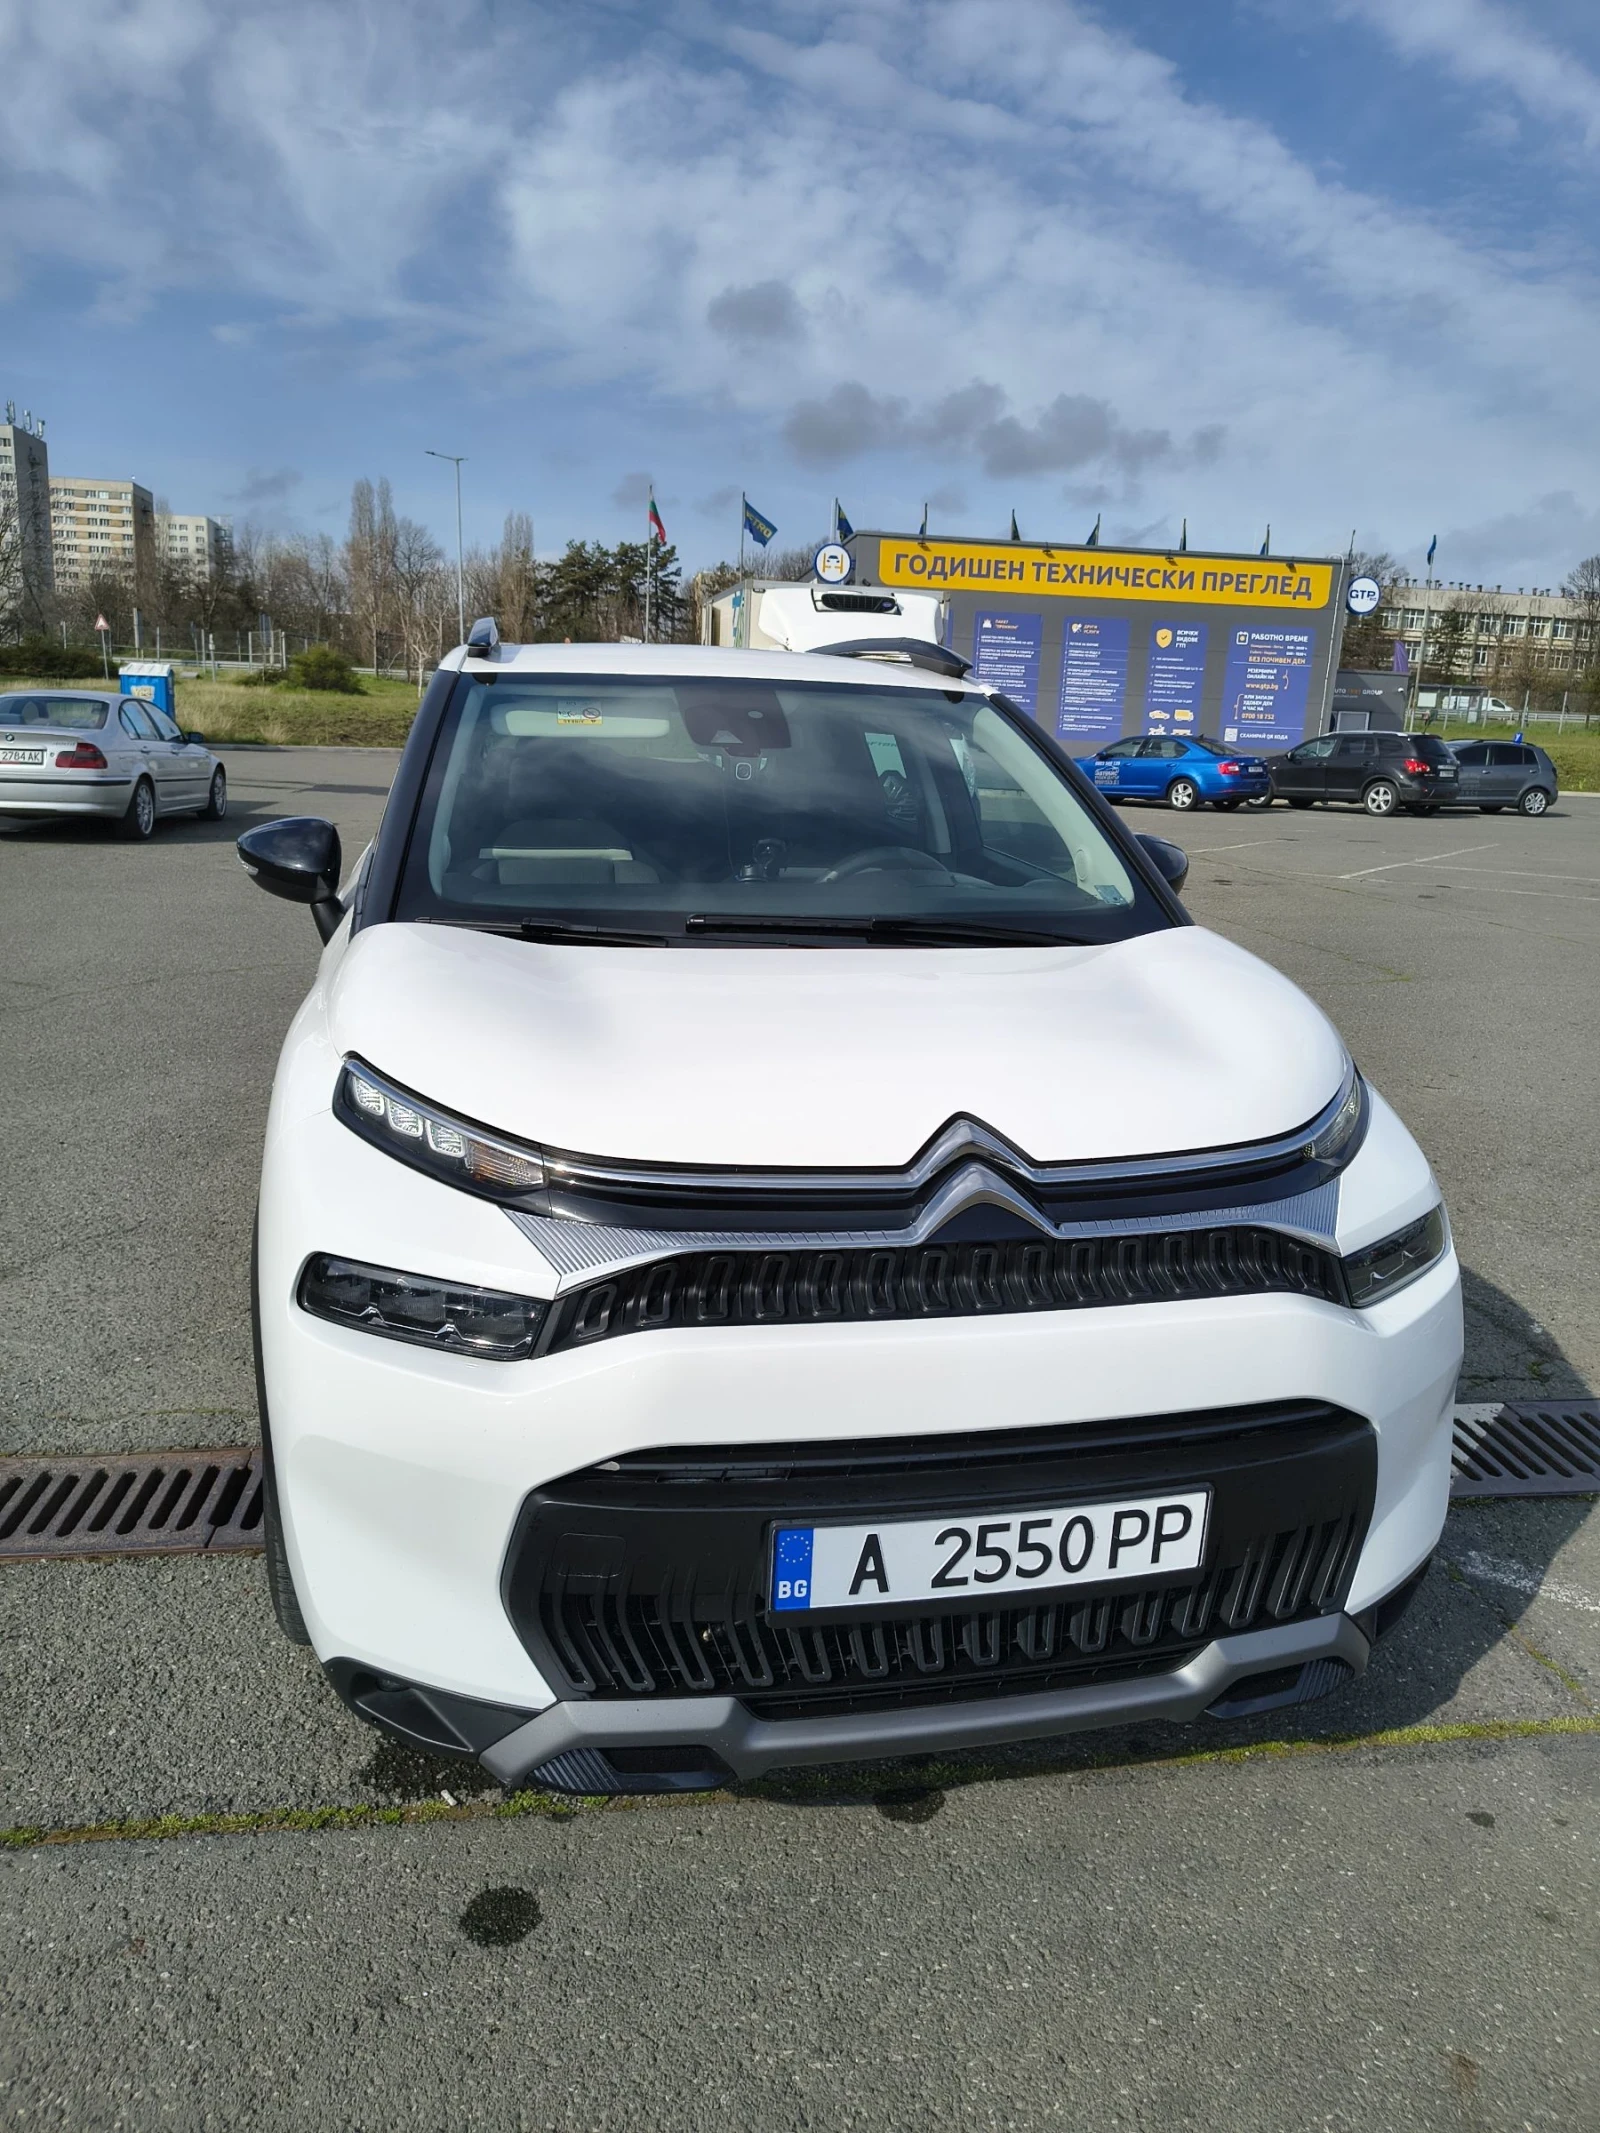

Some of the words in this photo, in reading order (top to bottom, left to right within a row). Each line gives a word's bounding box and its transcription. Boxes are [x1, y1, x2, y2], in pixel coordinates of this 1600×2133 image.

[895, 553, 1024, 581] ГОДИШЕН
[1032, 562, 1195, 590] ТЕХНИЧЕСКИ
[1201, 572, 1312, 600] ПРЕГЛЕД
[1251, 633, 1284, 641] РАБОТНО
[1285, 634, 1309, 643] ВРЕМЕ
[1261, 656, 1292, 664] ПОЧИВЕН
[2, 751, 26, 761] 2784
[27, 752, 40, 761] AK
[848, 1533, 890, 1595] A
[931, 1515, 1095, 1589] 2550
[1108, 1504, 1193, 1569] PP
[778, 1579, 808, 1599] BG
